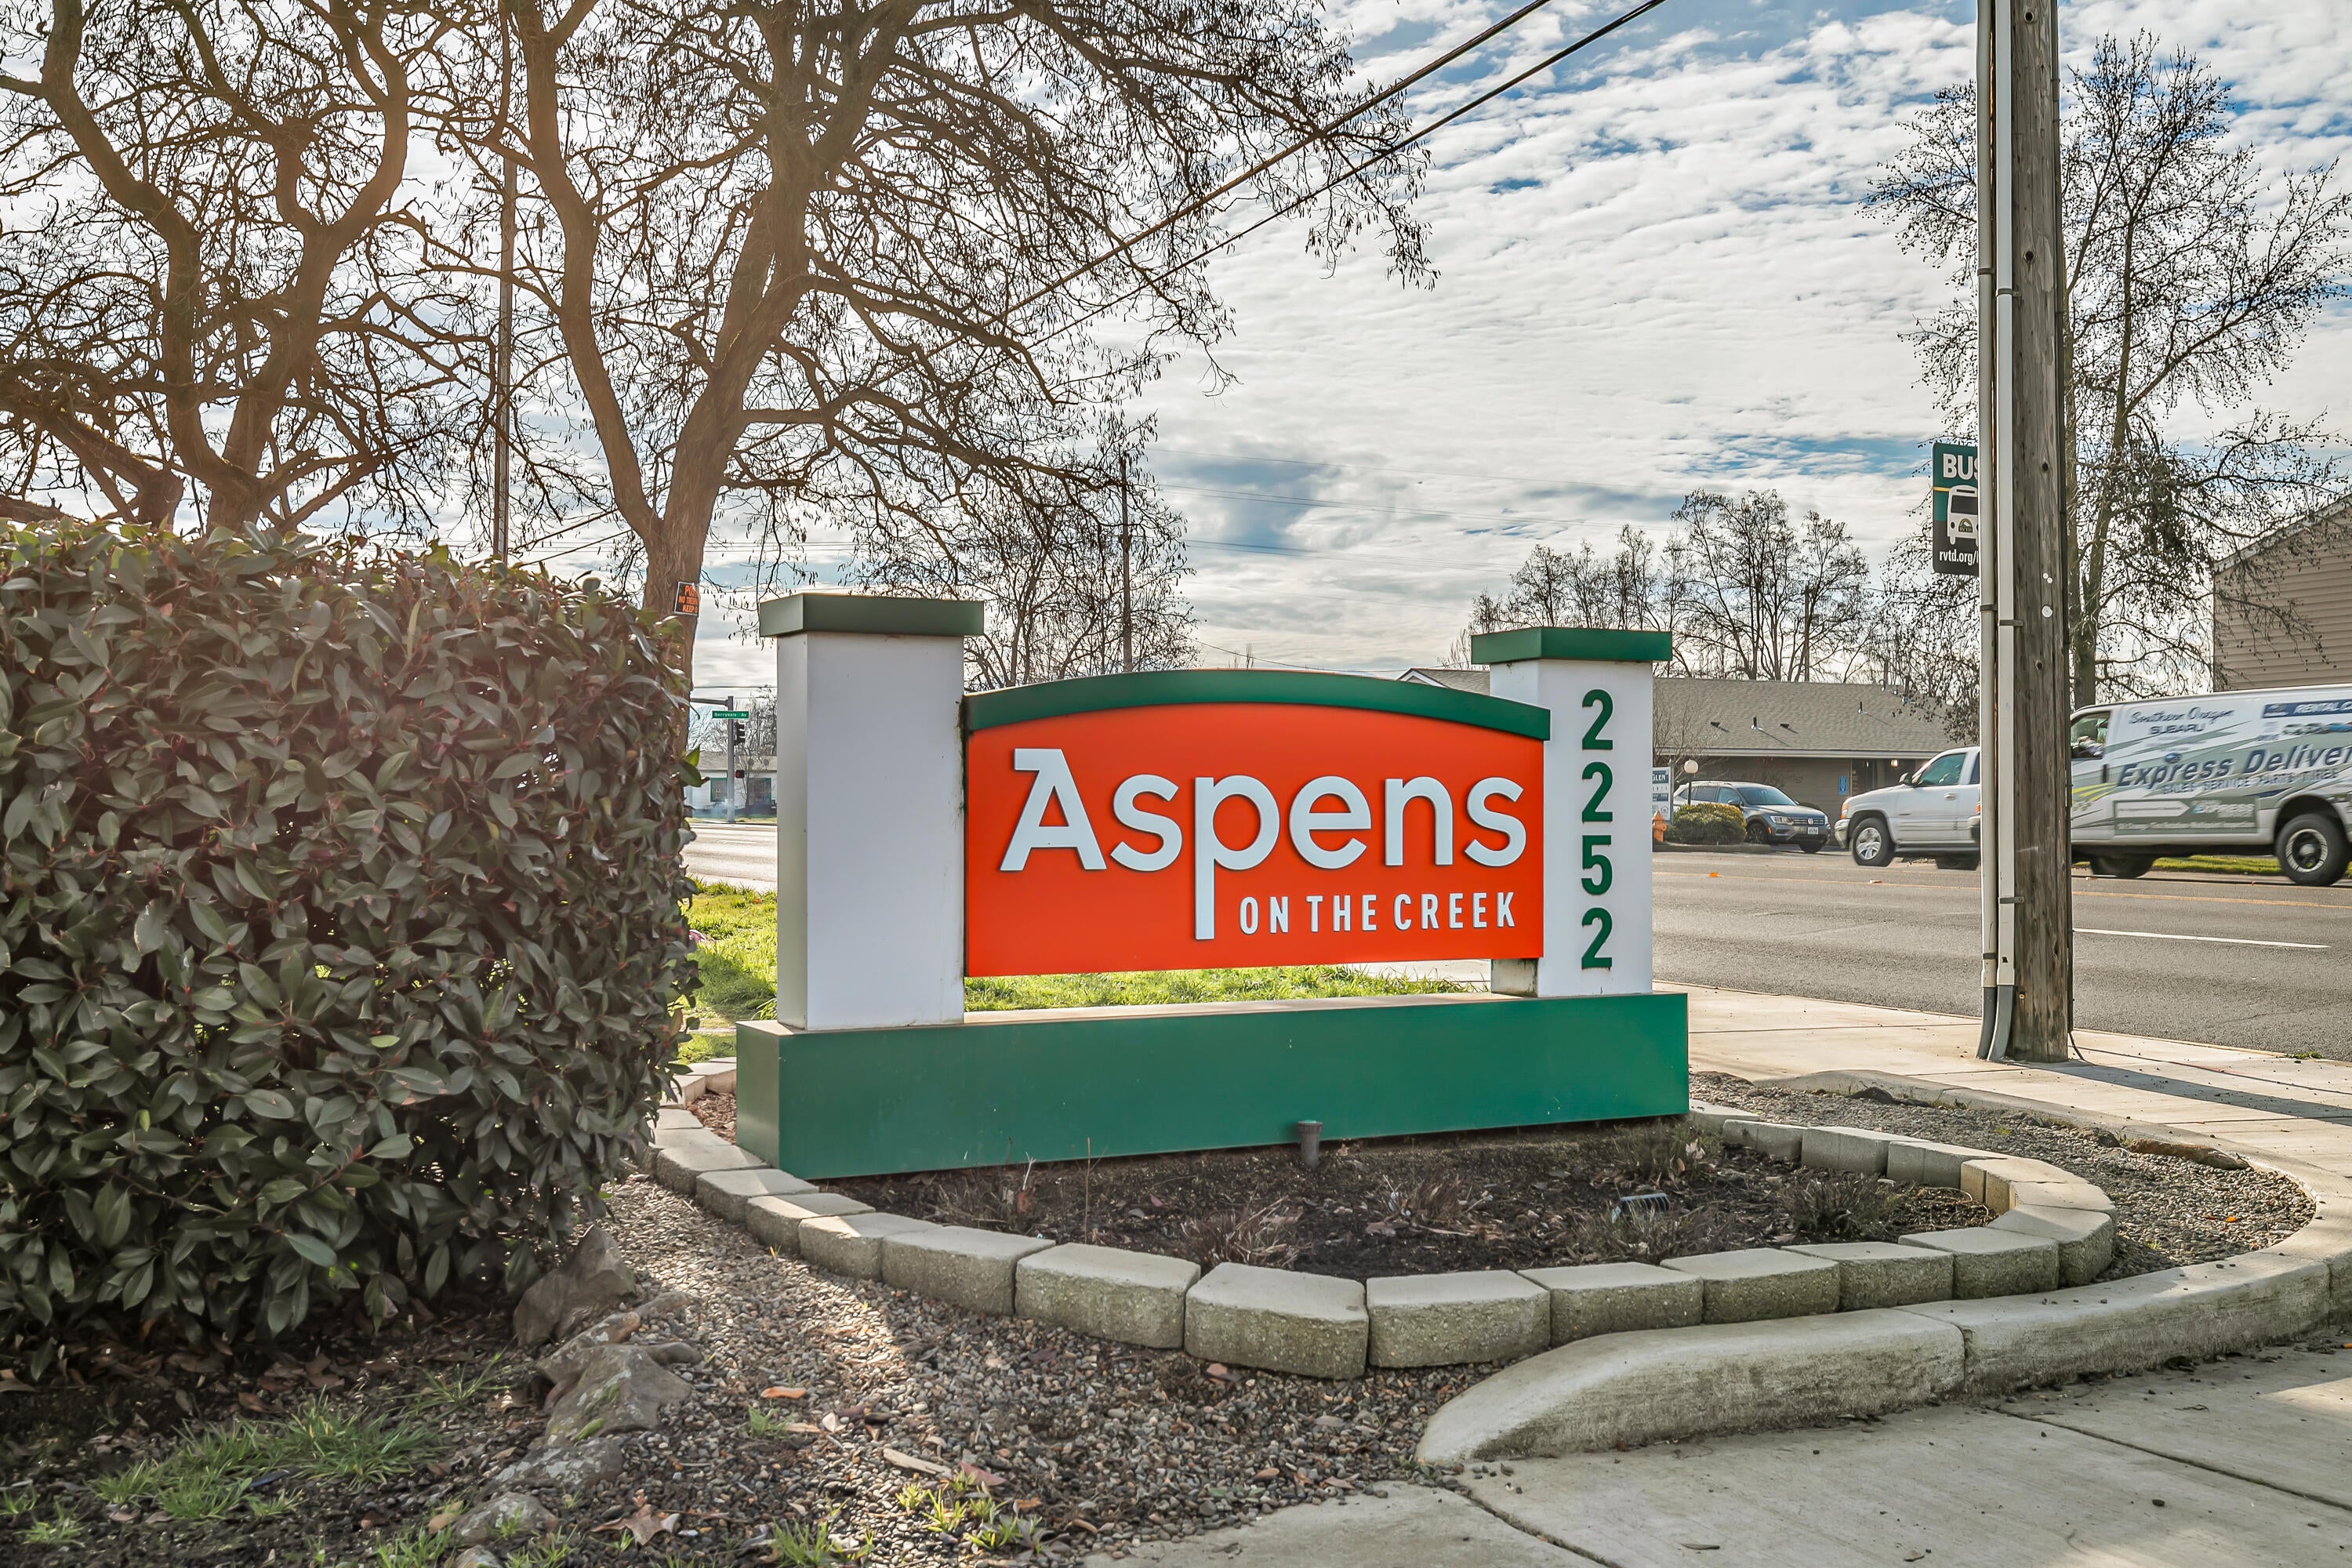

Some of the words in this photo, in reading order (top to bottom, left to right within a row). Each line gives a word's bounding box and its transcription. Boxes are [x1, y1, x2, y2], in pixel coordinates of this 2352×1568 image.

[1943, 453, 1978, 481] BU
[2129, 711, 2185, 724] Southern
[2187, 706, 2234, 724] Oregon
[2149, 724, 2206, 735] SUBARU
[2118, 757, 2235, 789] Express
[1000, 747, 1527, 941] Aspens
[1582, 689, 1613, 969] 2252
[1240, 895, 1290, 935] ON
[1306, 894, 1377, 933] THE
[1394, 891, 1516, 931] CREEK
